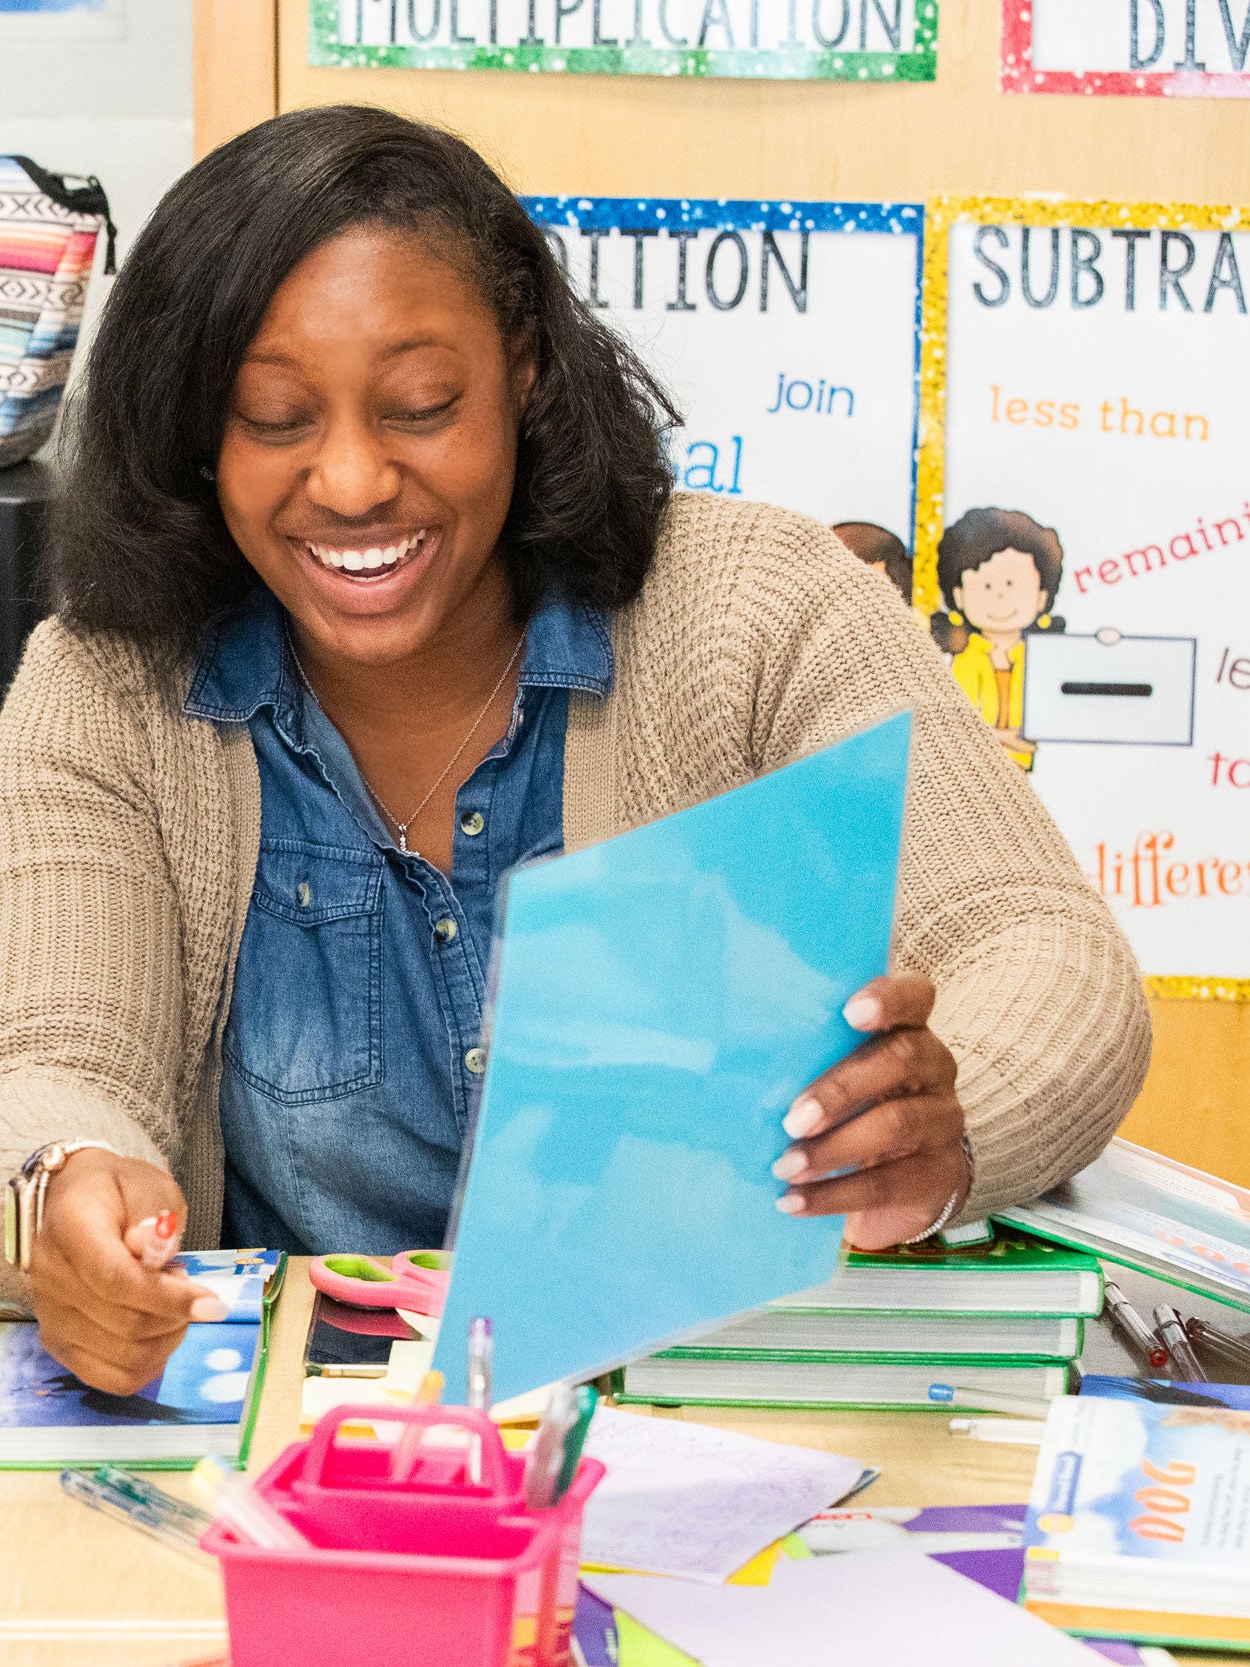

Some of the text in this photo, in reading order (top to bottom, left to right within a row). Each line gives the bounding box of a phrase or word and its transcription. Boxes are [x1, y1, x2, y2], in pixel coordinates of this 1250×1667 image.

[353, 0, 902, 50] MULTIPLICATION
[1129, 0, 1250, 71] DIV
[973, 225, 1248, 314] SUBTRA
[767, 372, 856, 417] join
[990, 384, 1210, 441] less than
[672, 434, 744, 494] al
[1073, 501, 1250, 593] remain
[1086, 830, 1250, 906] iffere
